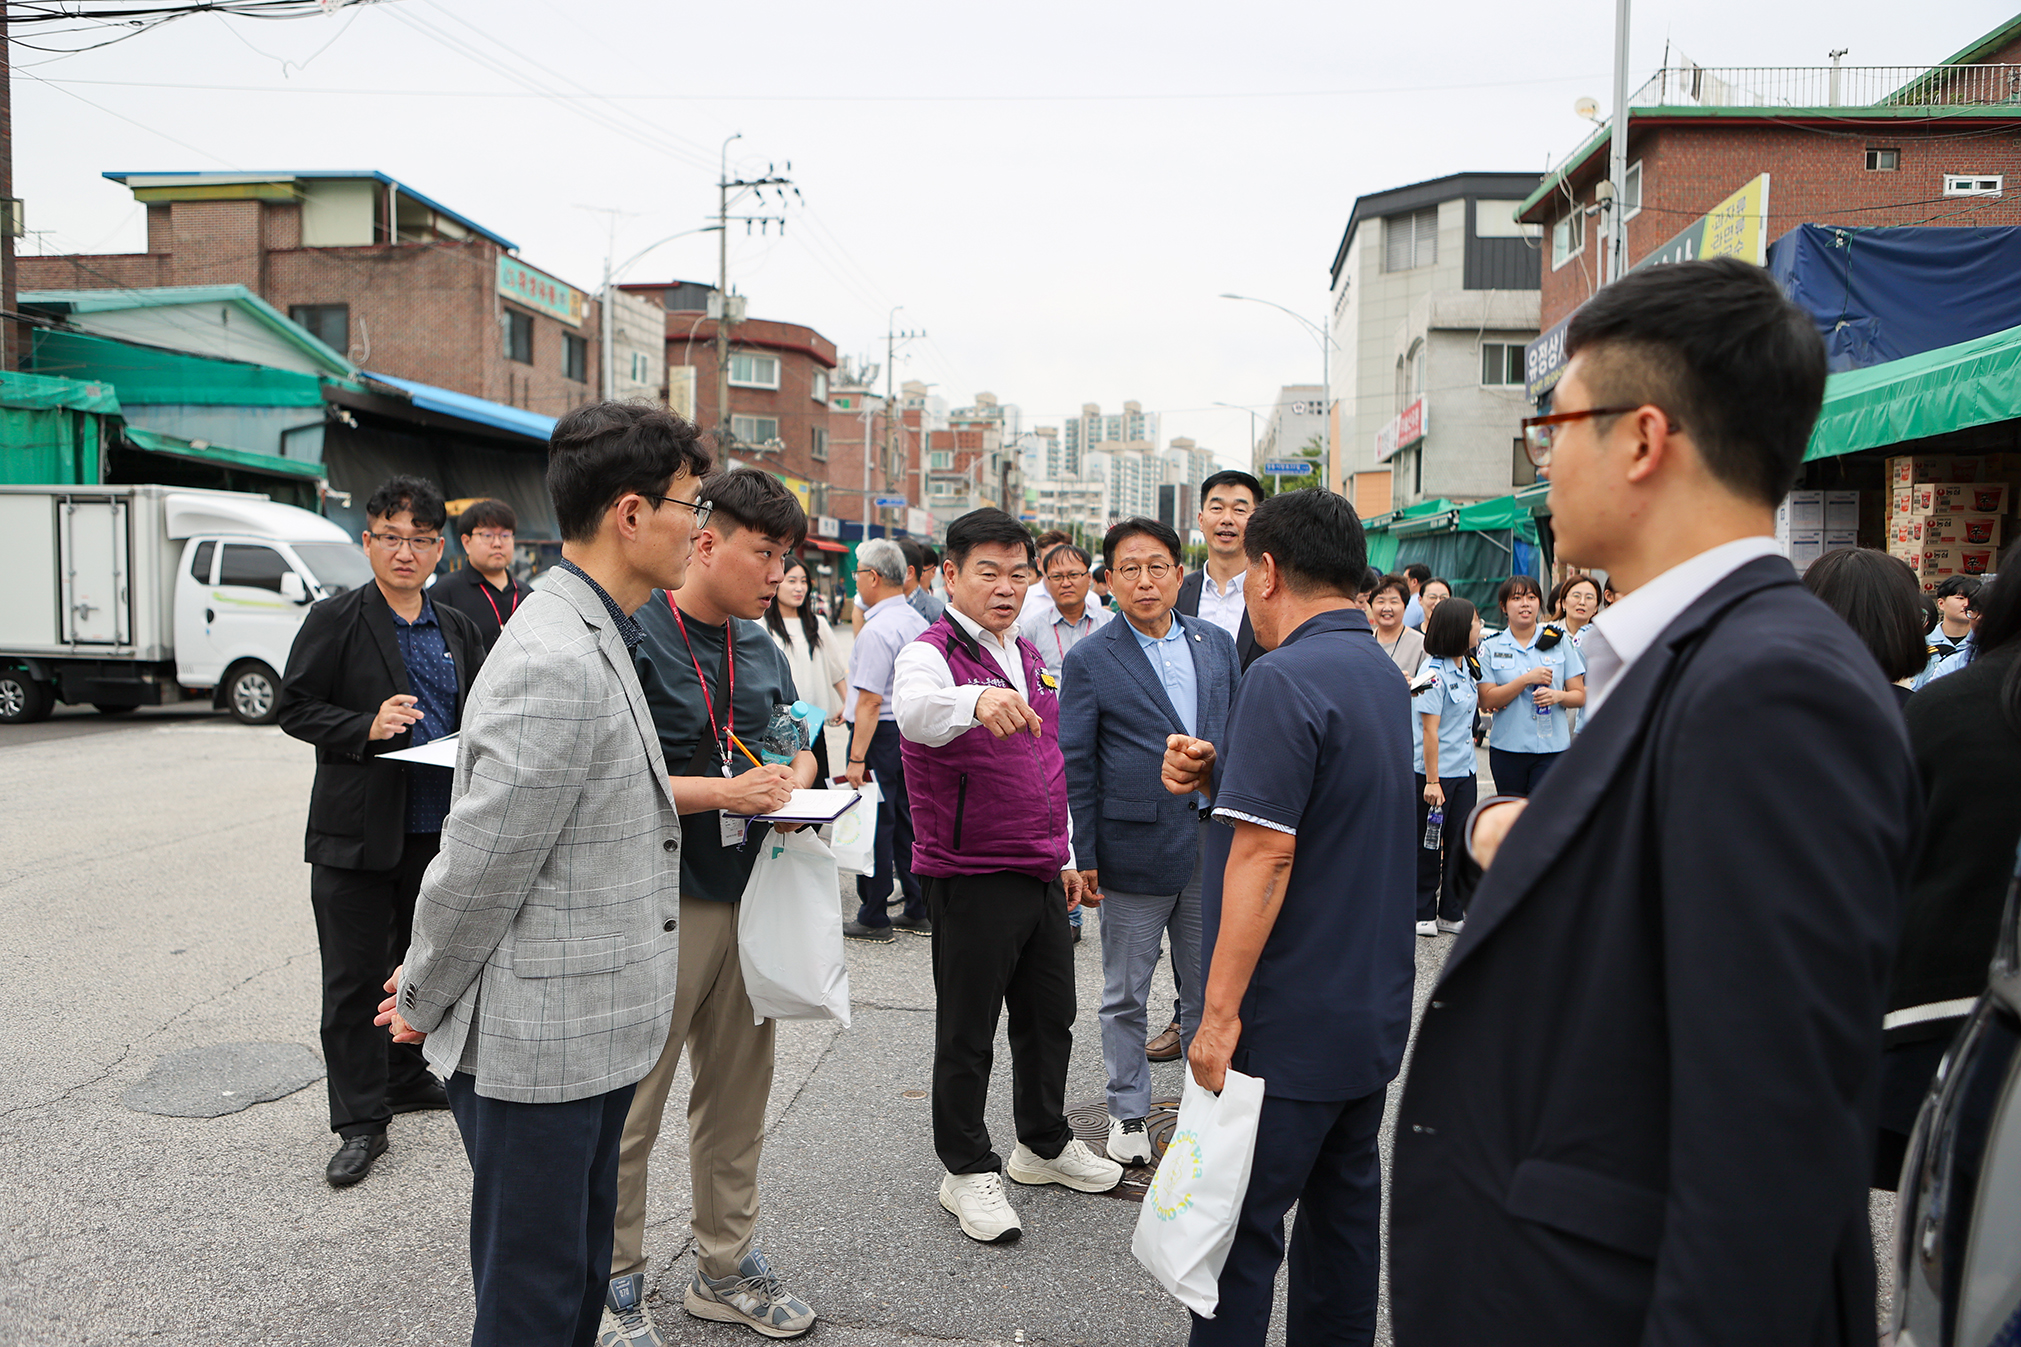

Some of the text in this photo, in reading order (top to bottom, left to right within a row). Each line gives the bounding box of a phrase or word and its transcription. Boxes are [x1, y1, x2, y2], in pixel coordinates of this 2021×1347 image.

[1713, 195, 1747, 231] 과자류
[1712, 216, 1746, 251] 라면류
[1970, 525, 1983, 540] 辛
[1967, 556, 1980, 571] 辛
